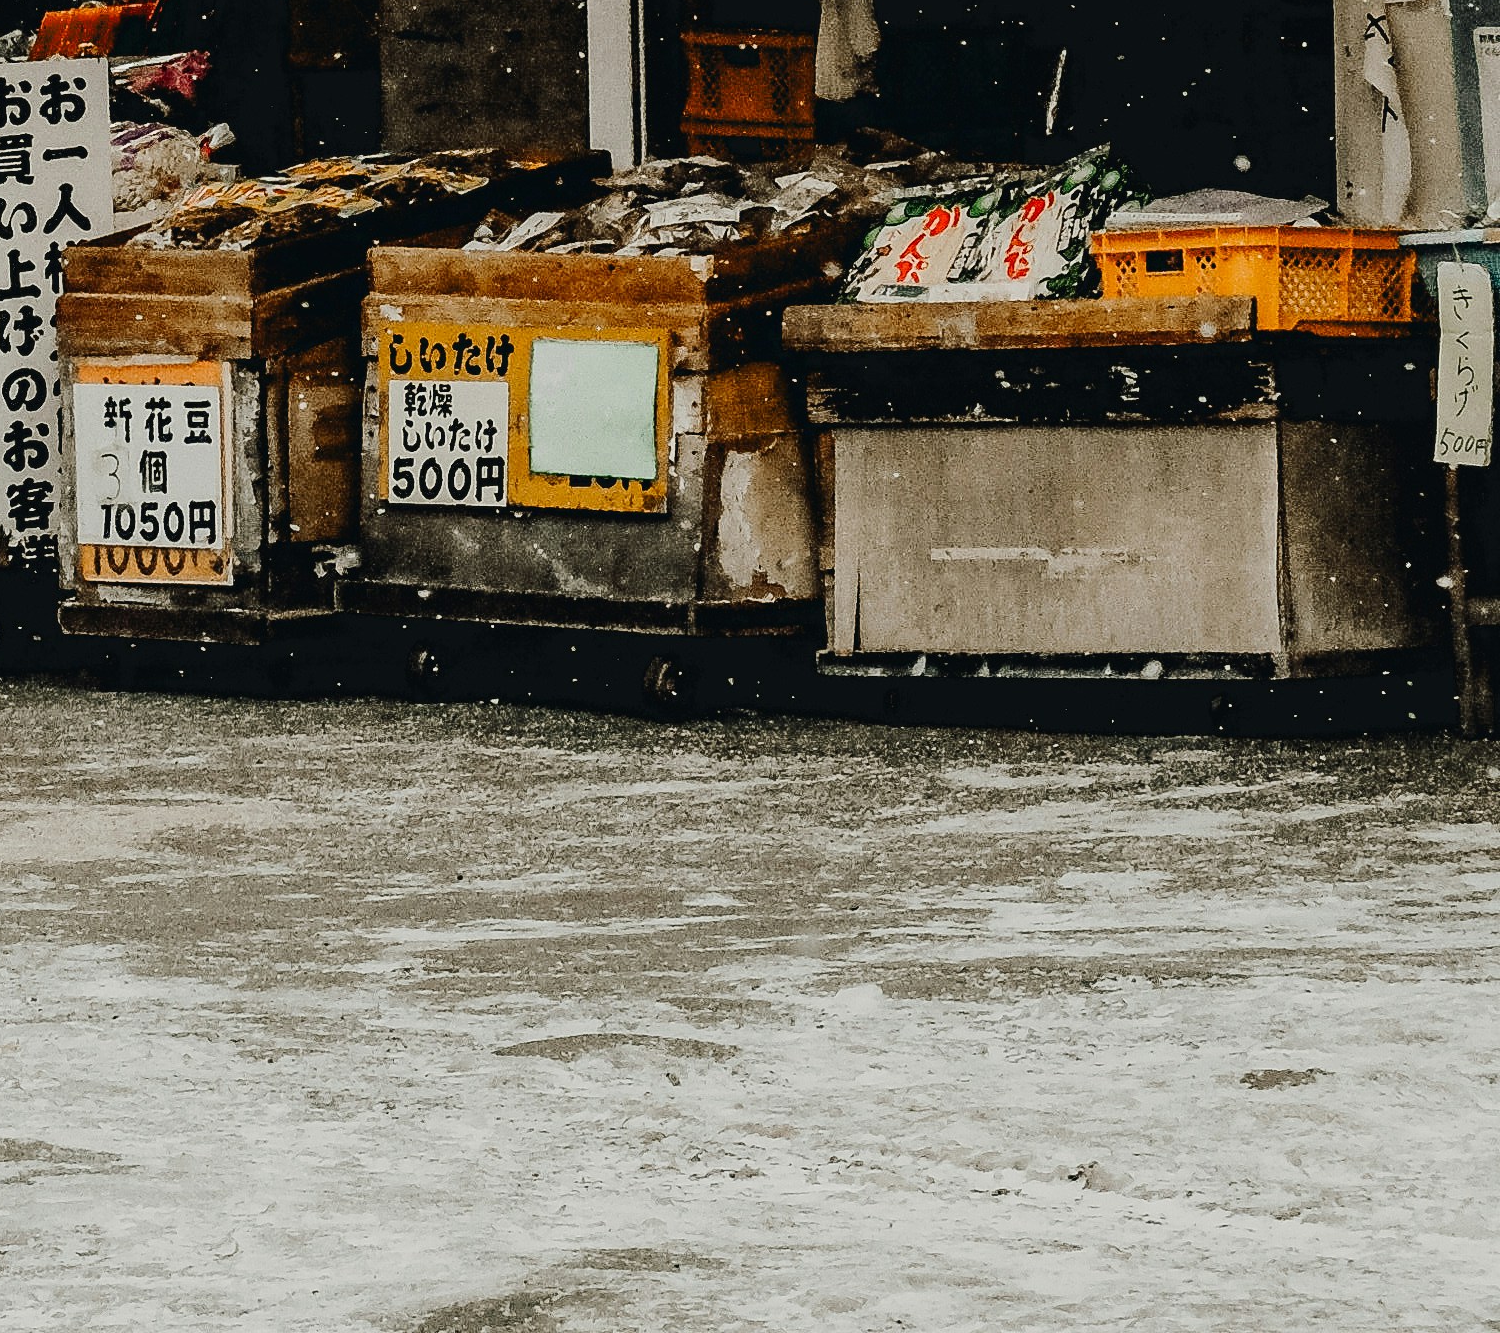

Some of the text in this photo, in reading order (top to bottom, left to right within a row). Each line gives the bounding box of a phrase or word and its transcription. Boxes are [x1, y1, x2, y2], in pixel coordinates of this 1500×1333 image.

[389, 333, 515, 376] しいたけ
[1452, 285, 1479, 418] きくらげ
[103, 396, 213, 445] 新花豆
[403, 382, 453, 419] 乾燥
[402, 417, 498, 453] しいたけ
[392, 456, 506, 503] 500円
[101, 500, 217, 546] 1050円
